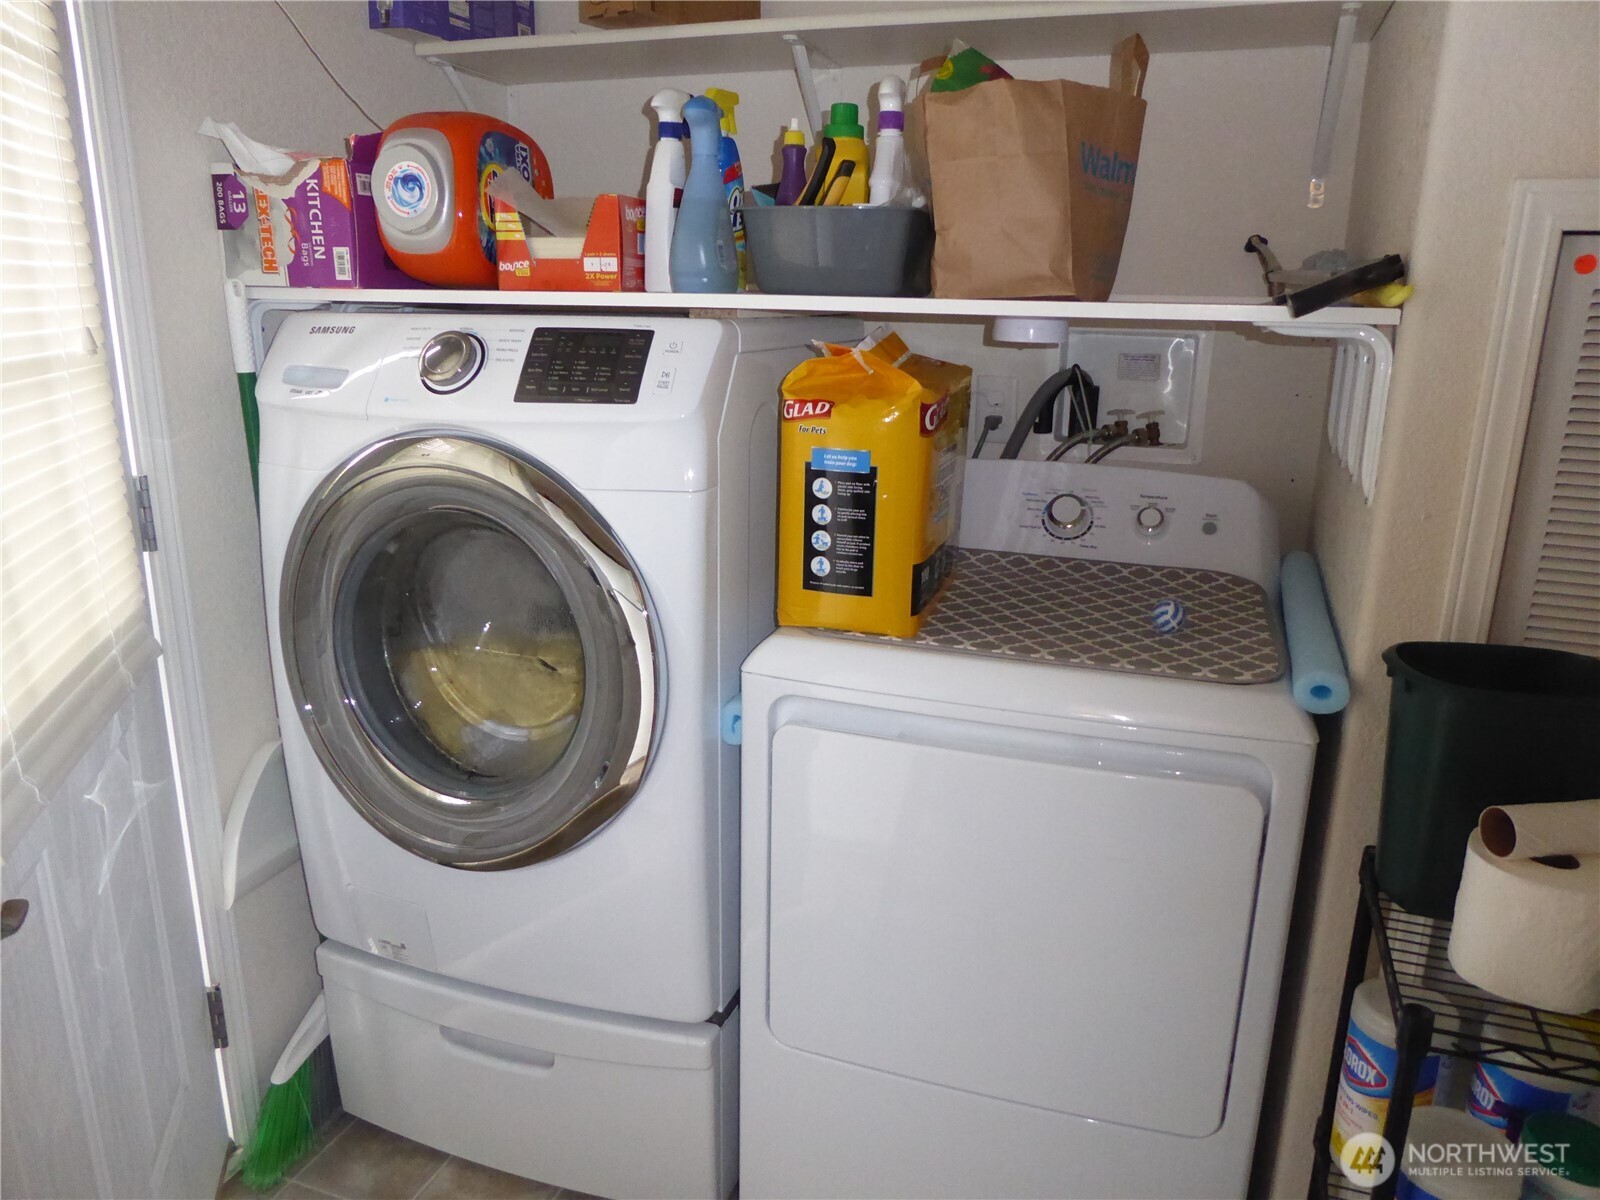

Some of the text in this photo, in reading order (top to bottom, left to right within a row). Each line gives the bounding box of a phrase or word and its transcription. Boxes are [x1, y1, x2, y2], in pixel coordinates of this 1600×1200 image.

[215, 181, 227, 225] 200 BAGS
[232, 190, 247, 214] 13
[305, 178, 327, 260] KITCHEN
[300, 242, 310, 267] Bags
[499, 260, 530, 272] bounce
[585, 272, 617, 280] 2X Power
[309, 325, 357, 335] SAMSUNG
[783, 400, 831, 419] GLAD
[798, 425, 827, 435] for Pets
